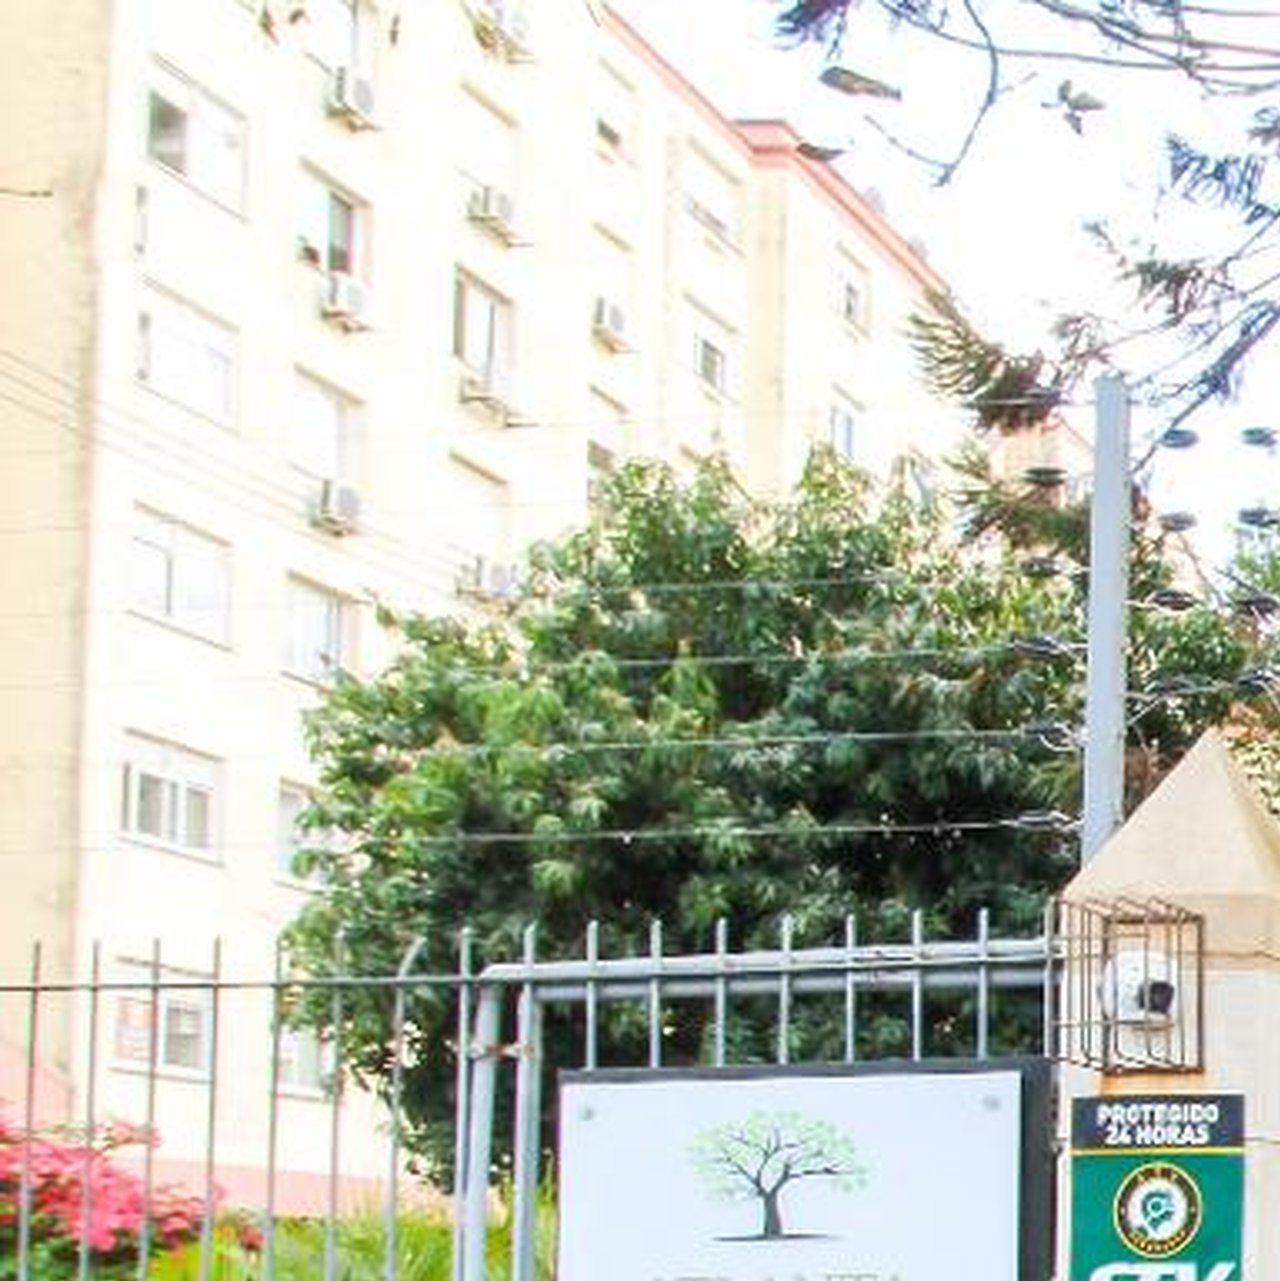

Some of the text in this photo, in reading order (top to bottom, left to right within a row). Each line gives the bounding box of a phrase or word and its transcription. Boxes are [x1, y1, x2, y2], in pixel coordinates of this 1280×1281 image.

[1096, 1103, 1220, 1126] PROTEGIDO
[1104, 1124, 1210, 1145] 24 HORAS
